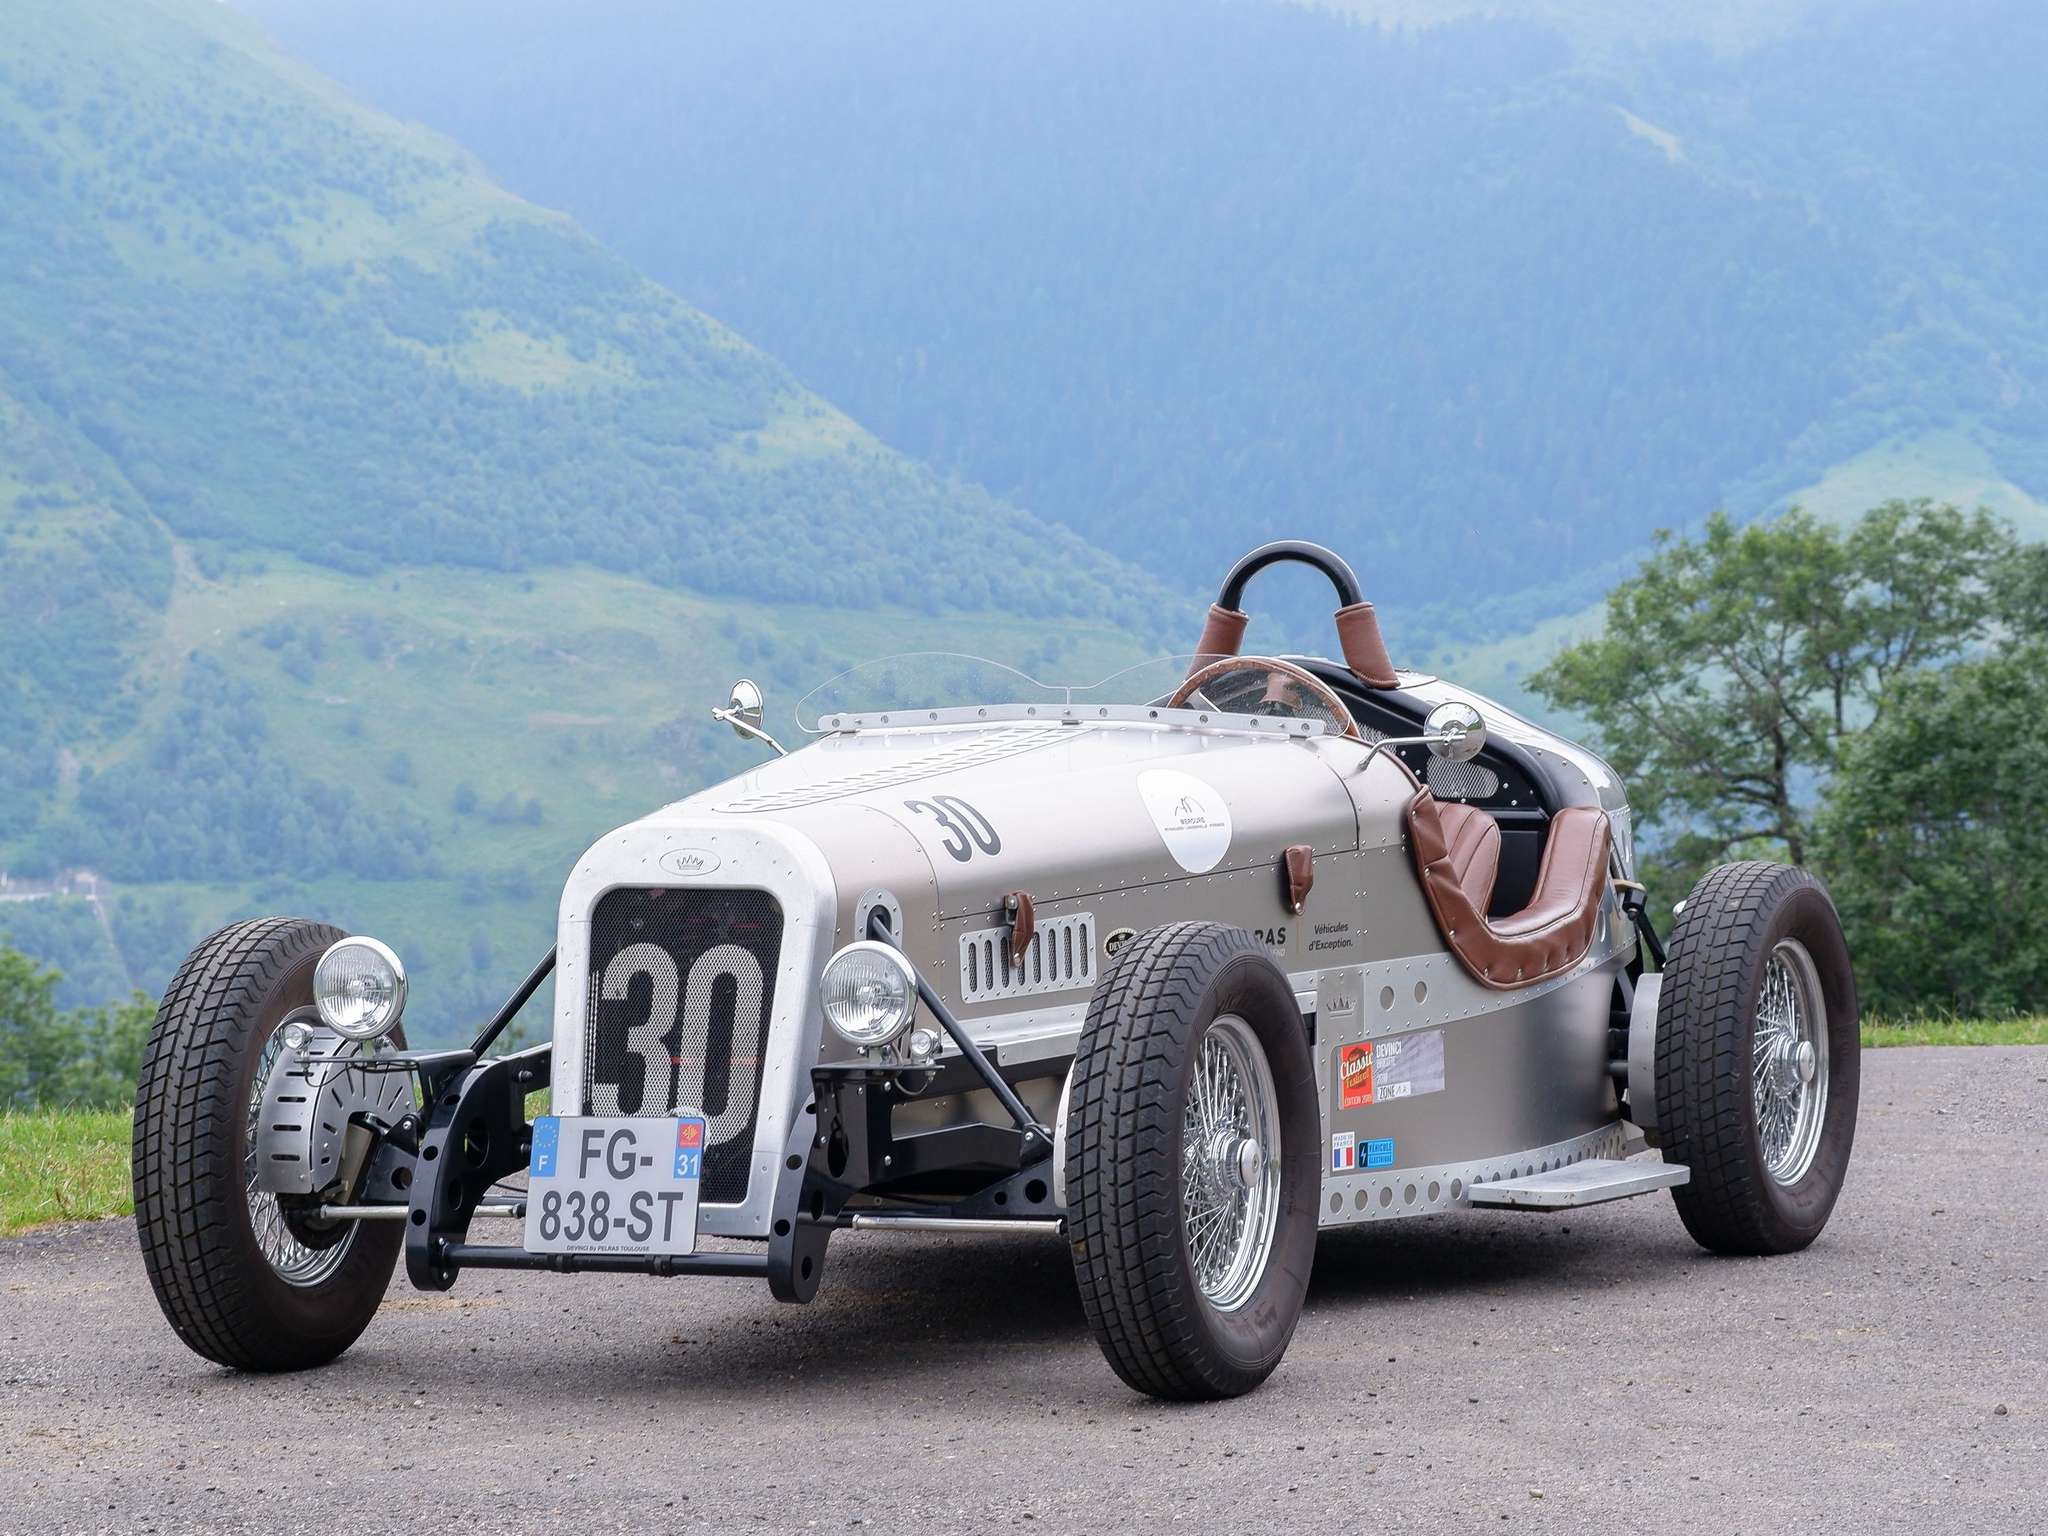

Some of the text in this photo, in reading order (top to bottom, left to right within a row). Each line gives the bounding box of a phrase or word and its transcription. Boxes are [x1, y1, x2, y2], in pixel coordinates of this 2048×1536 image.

[903, 795, 1002, 863] 30
[1313, 923, 1350, 936] Véhicules
[591, 942, 763, 1145] 30
[1376, 1041, 1402, 1058] DEVINCI
[1340, 1051, 1373, 1080] Classic
[1379, 1085, 1394, 1100] ZONE
[538, 1155, 548, 1171] F
[579, 1128, 653, 1180] FG-
[677, 1153, 699, 1176] 31
[539, 1190, 684, 1242] 838-ST
